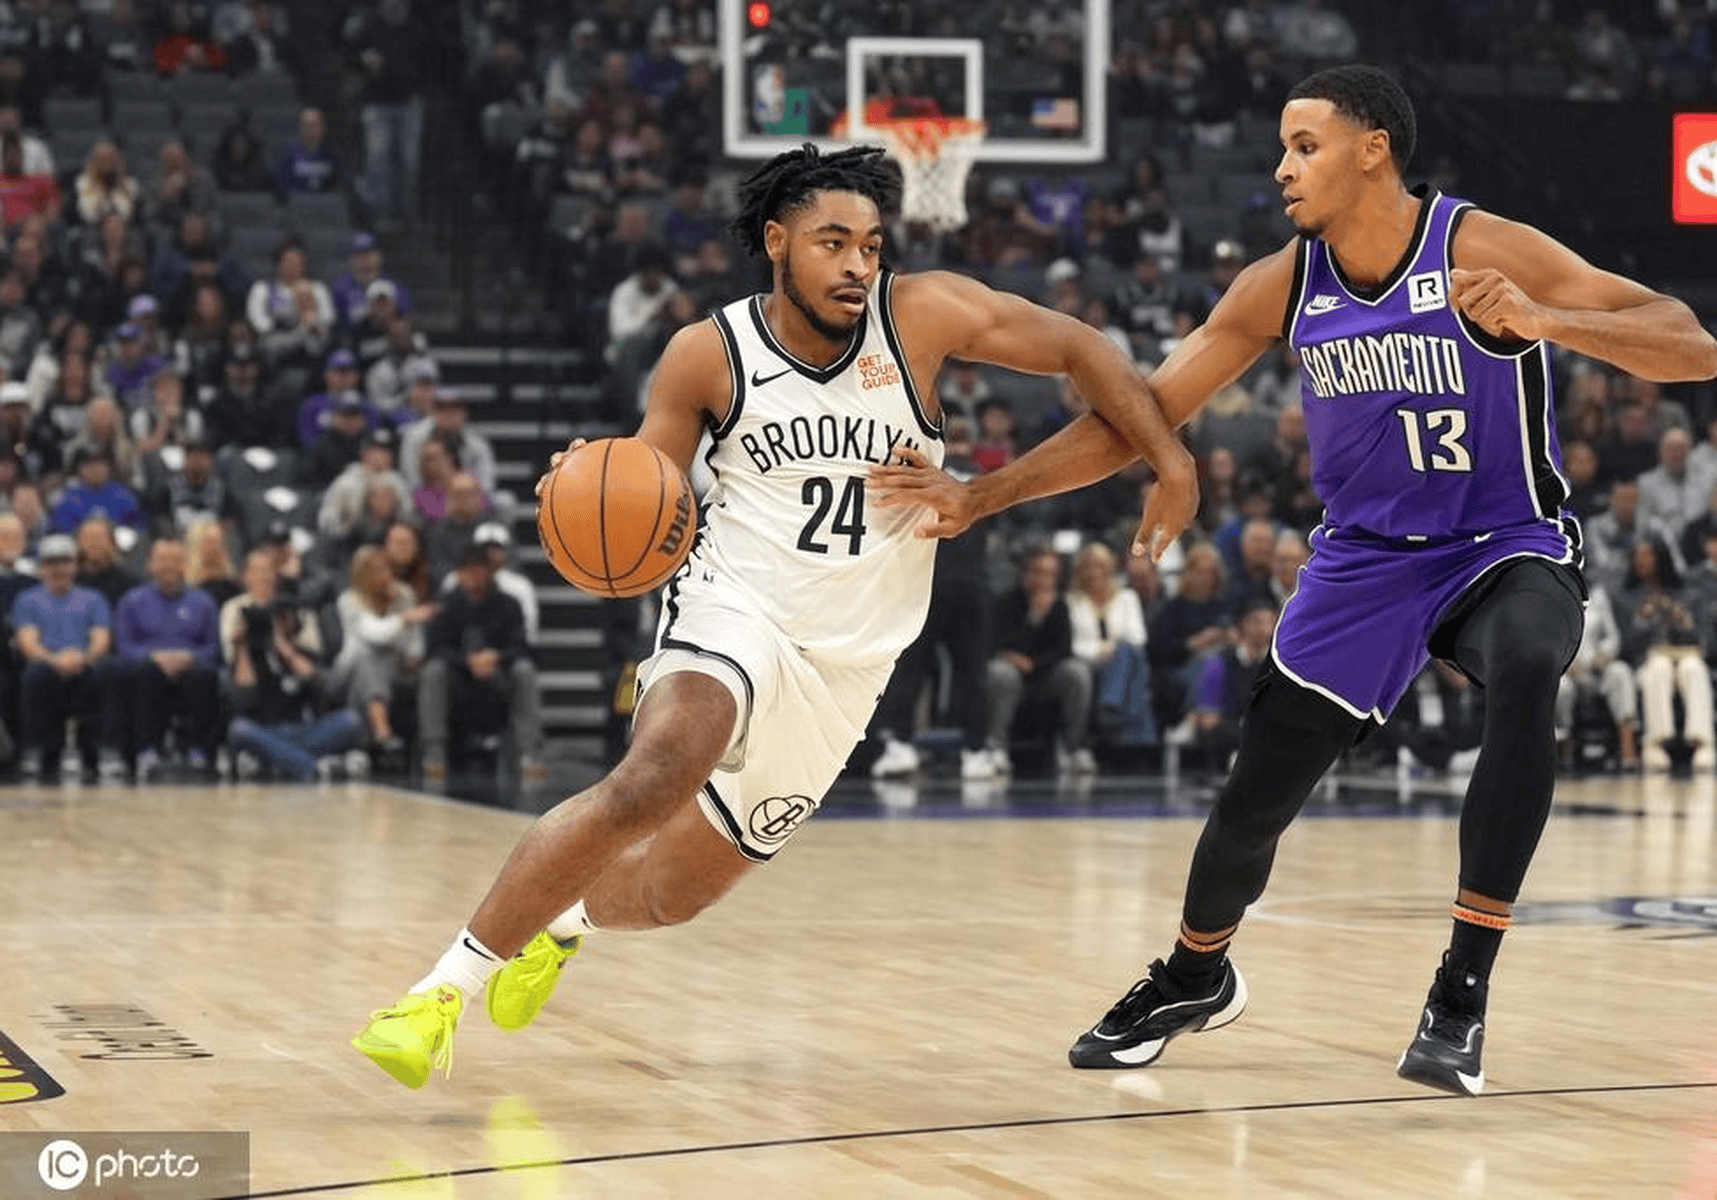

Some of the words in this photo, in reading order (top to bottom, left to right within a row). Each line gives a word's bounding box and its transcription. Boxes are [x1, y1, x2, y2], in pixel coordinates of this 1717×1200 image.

[1312, 294, 1340, 307] NIKE
[857, 354, 881, 368] GET
[1300, 333, 1465, 398] SACRAMENTO
[860, 363, 896, 378] YOUR
[862, 374, 900, 390] GUIDE
[1396, 409, 1472, 472] 13
[796, 476, 866, 556] 24
